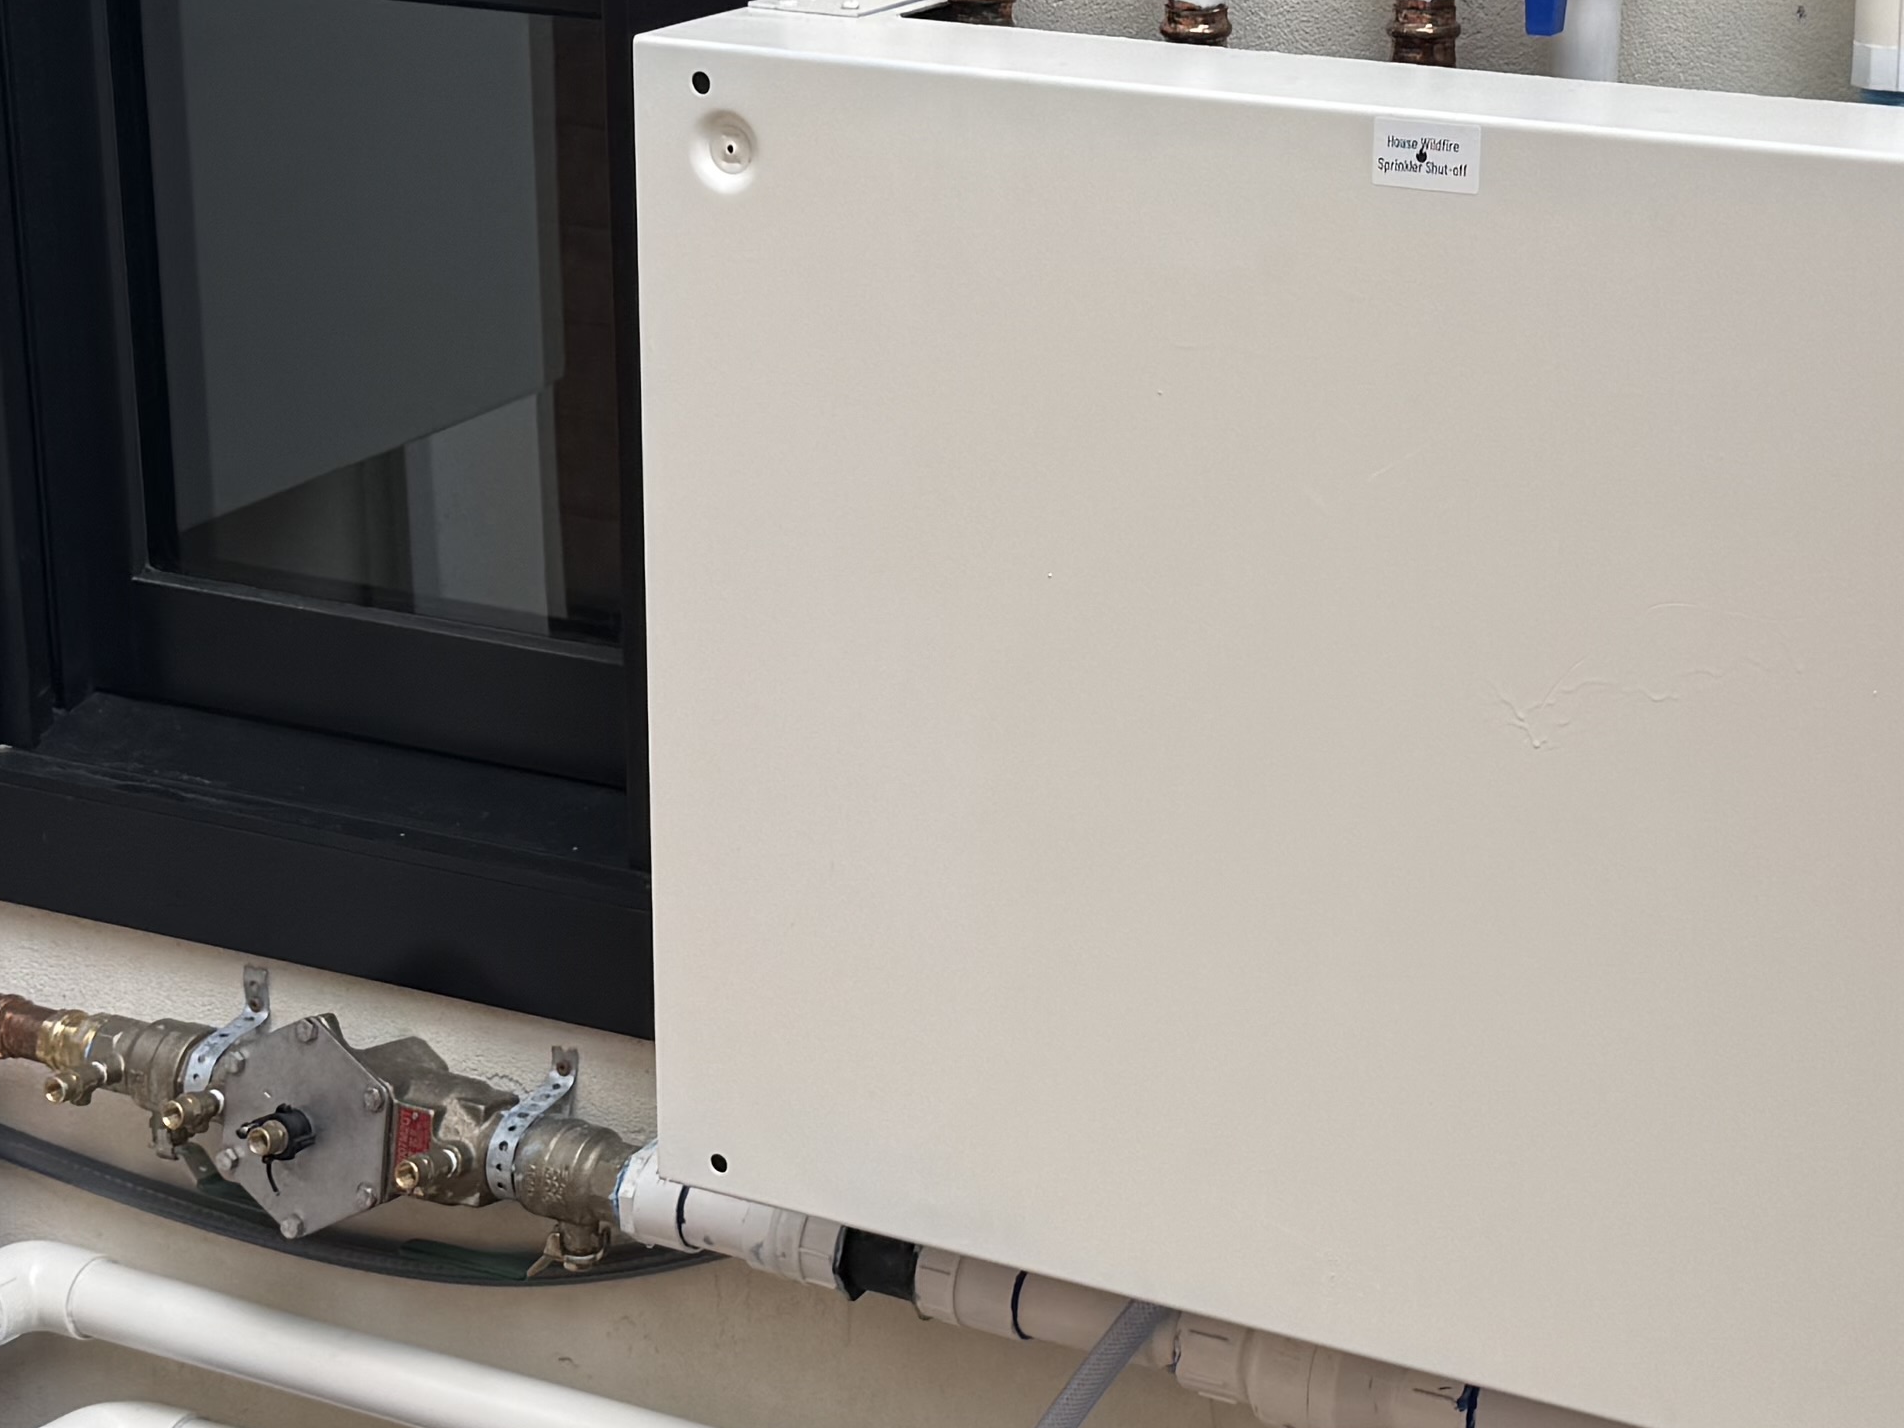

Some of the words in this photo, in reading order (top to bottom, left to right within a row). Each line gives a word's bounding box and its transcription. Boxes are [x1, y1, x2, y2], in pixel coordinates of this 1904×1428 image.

[1387, 135, 1418, 149] House
[1420, 137, 1460, 152] Wildfire
[1377, 157, 1422, 173] Sprinkler
[1425, 161, 1467, 177] Shut-off
